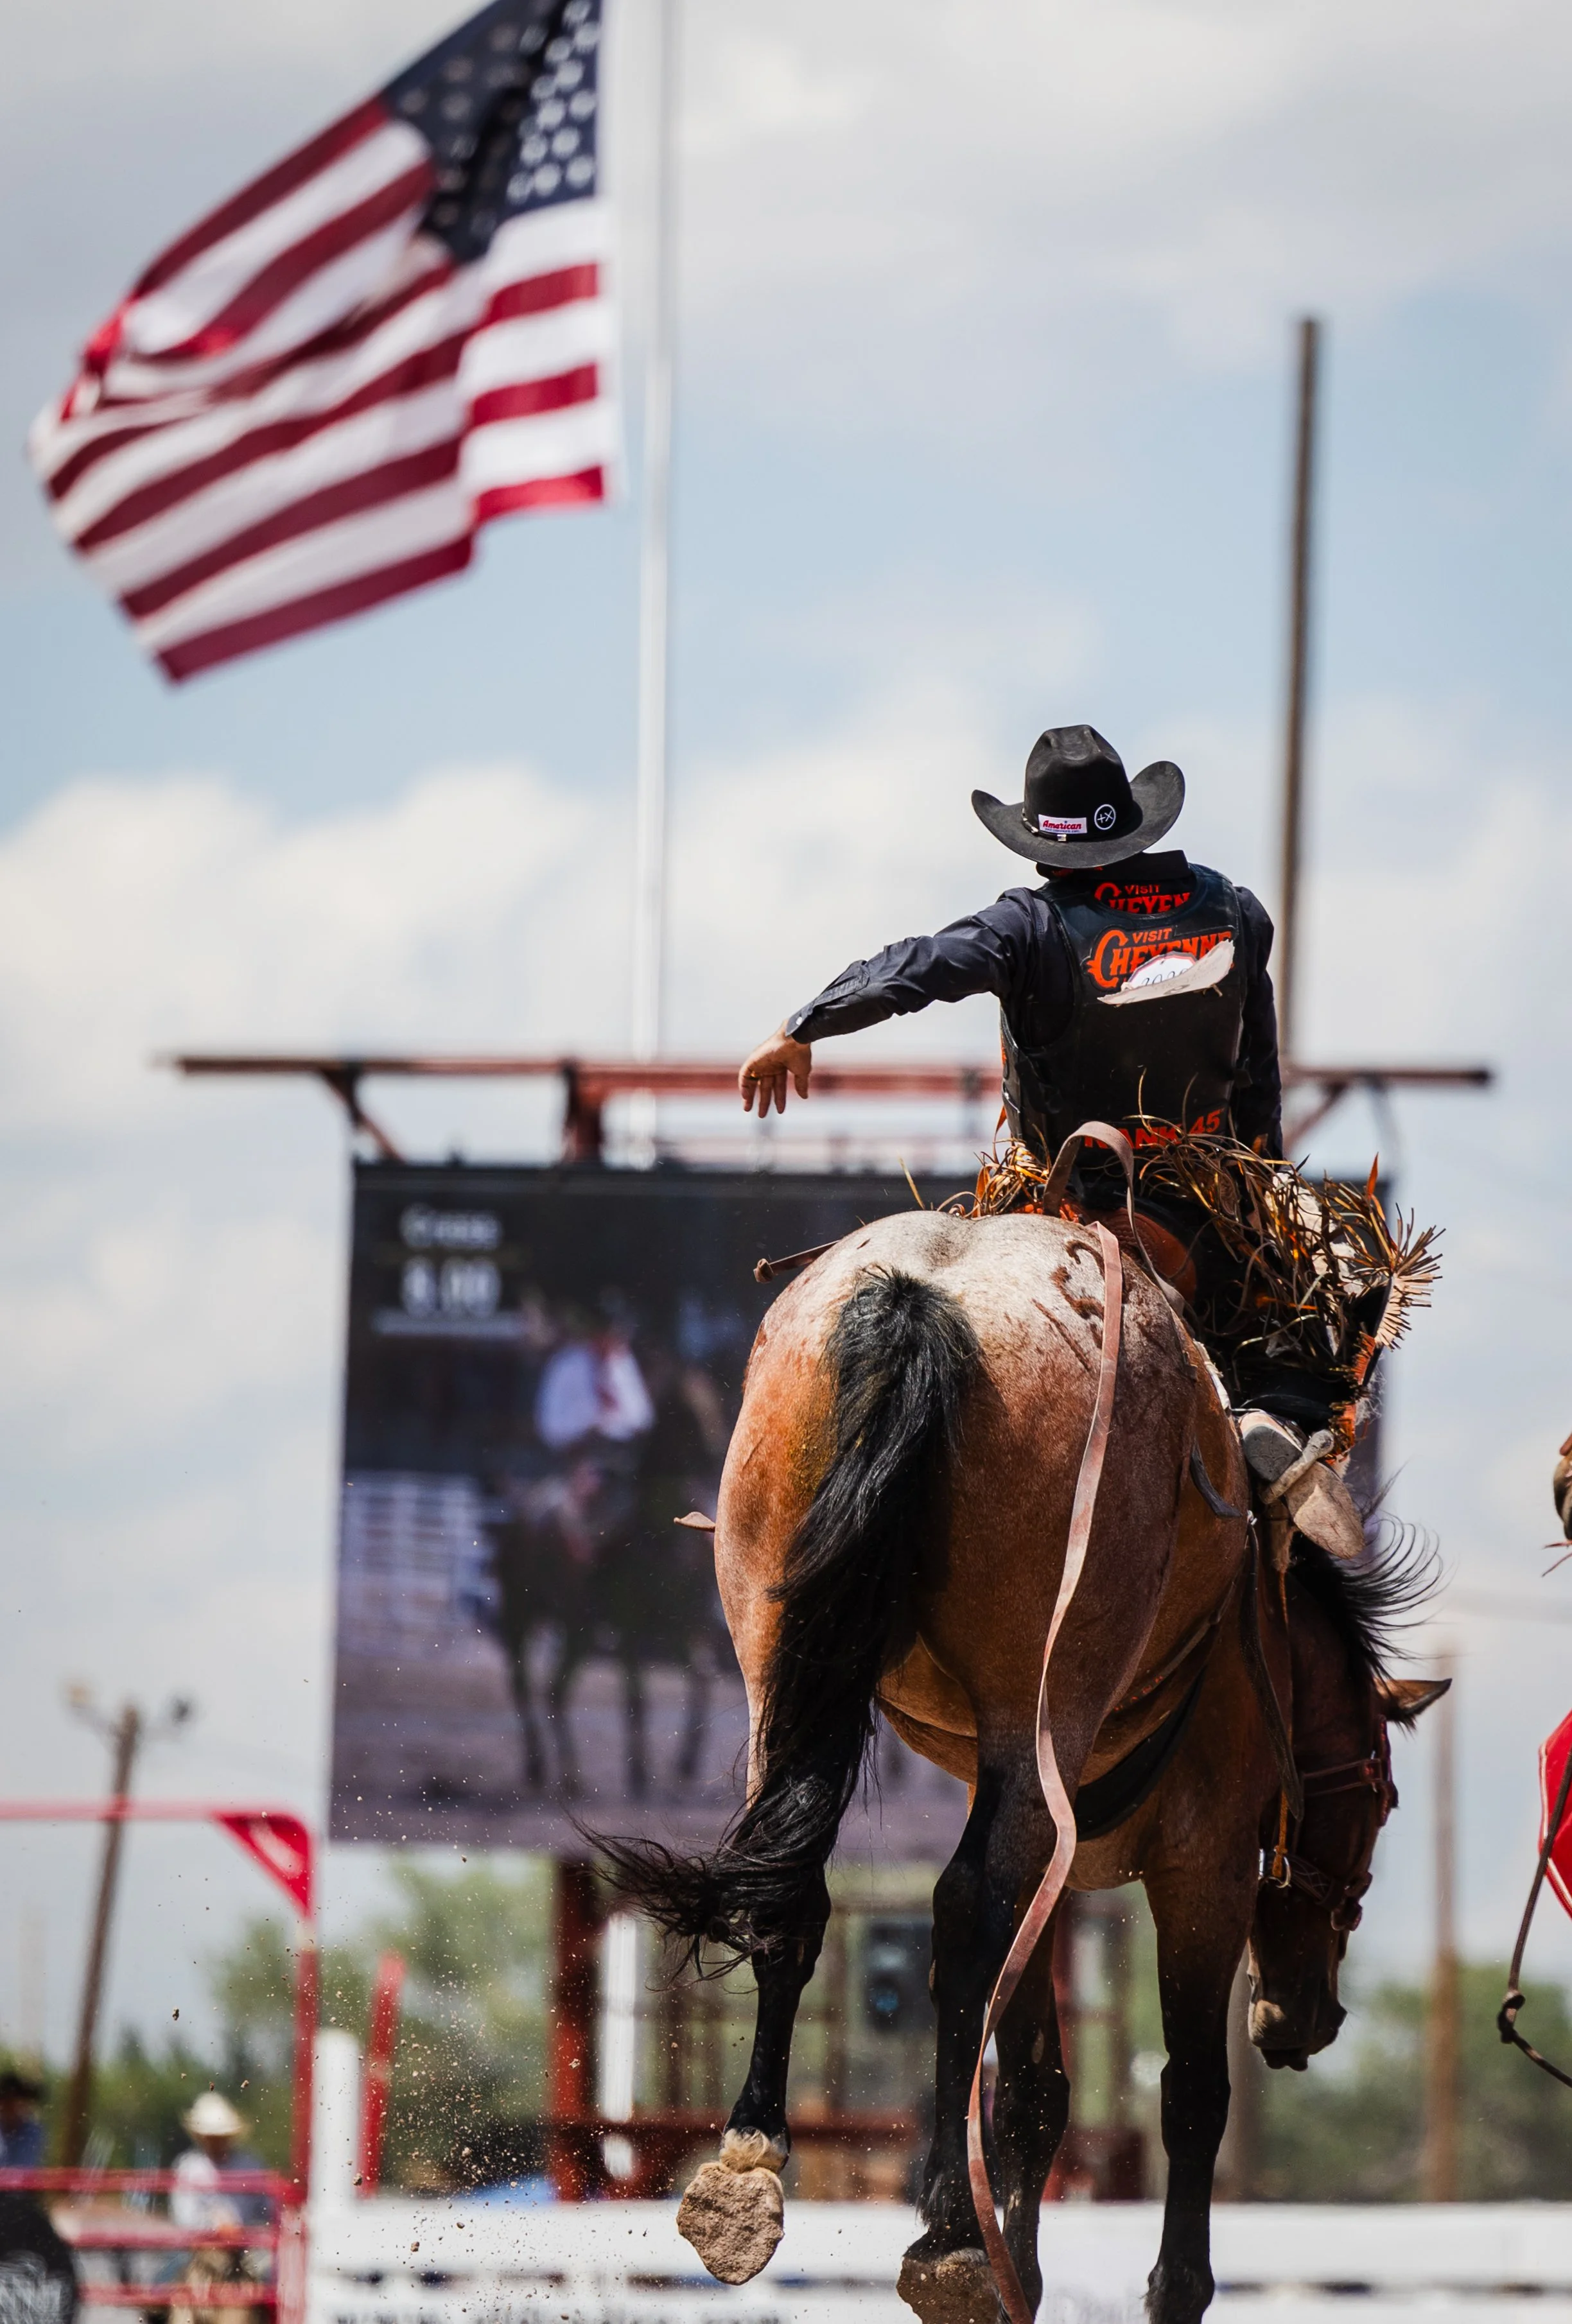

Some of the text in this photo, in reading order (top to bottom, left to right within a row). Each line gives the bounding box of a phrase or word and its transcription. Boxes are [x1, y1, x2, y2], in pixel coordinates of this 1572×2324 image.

[1125, 884, 1161, 895] VISIT
[1132, 928, 1172, 944] VISIT
[1189, 1108, 1224, 1135] 45
